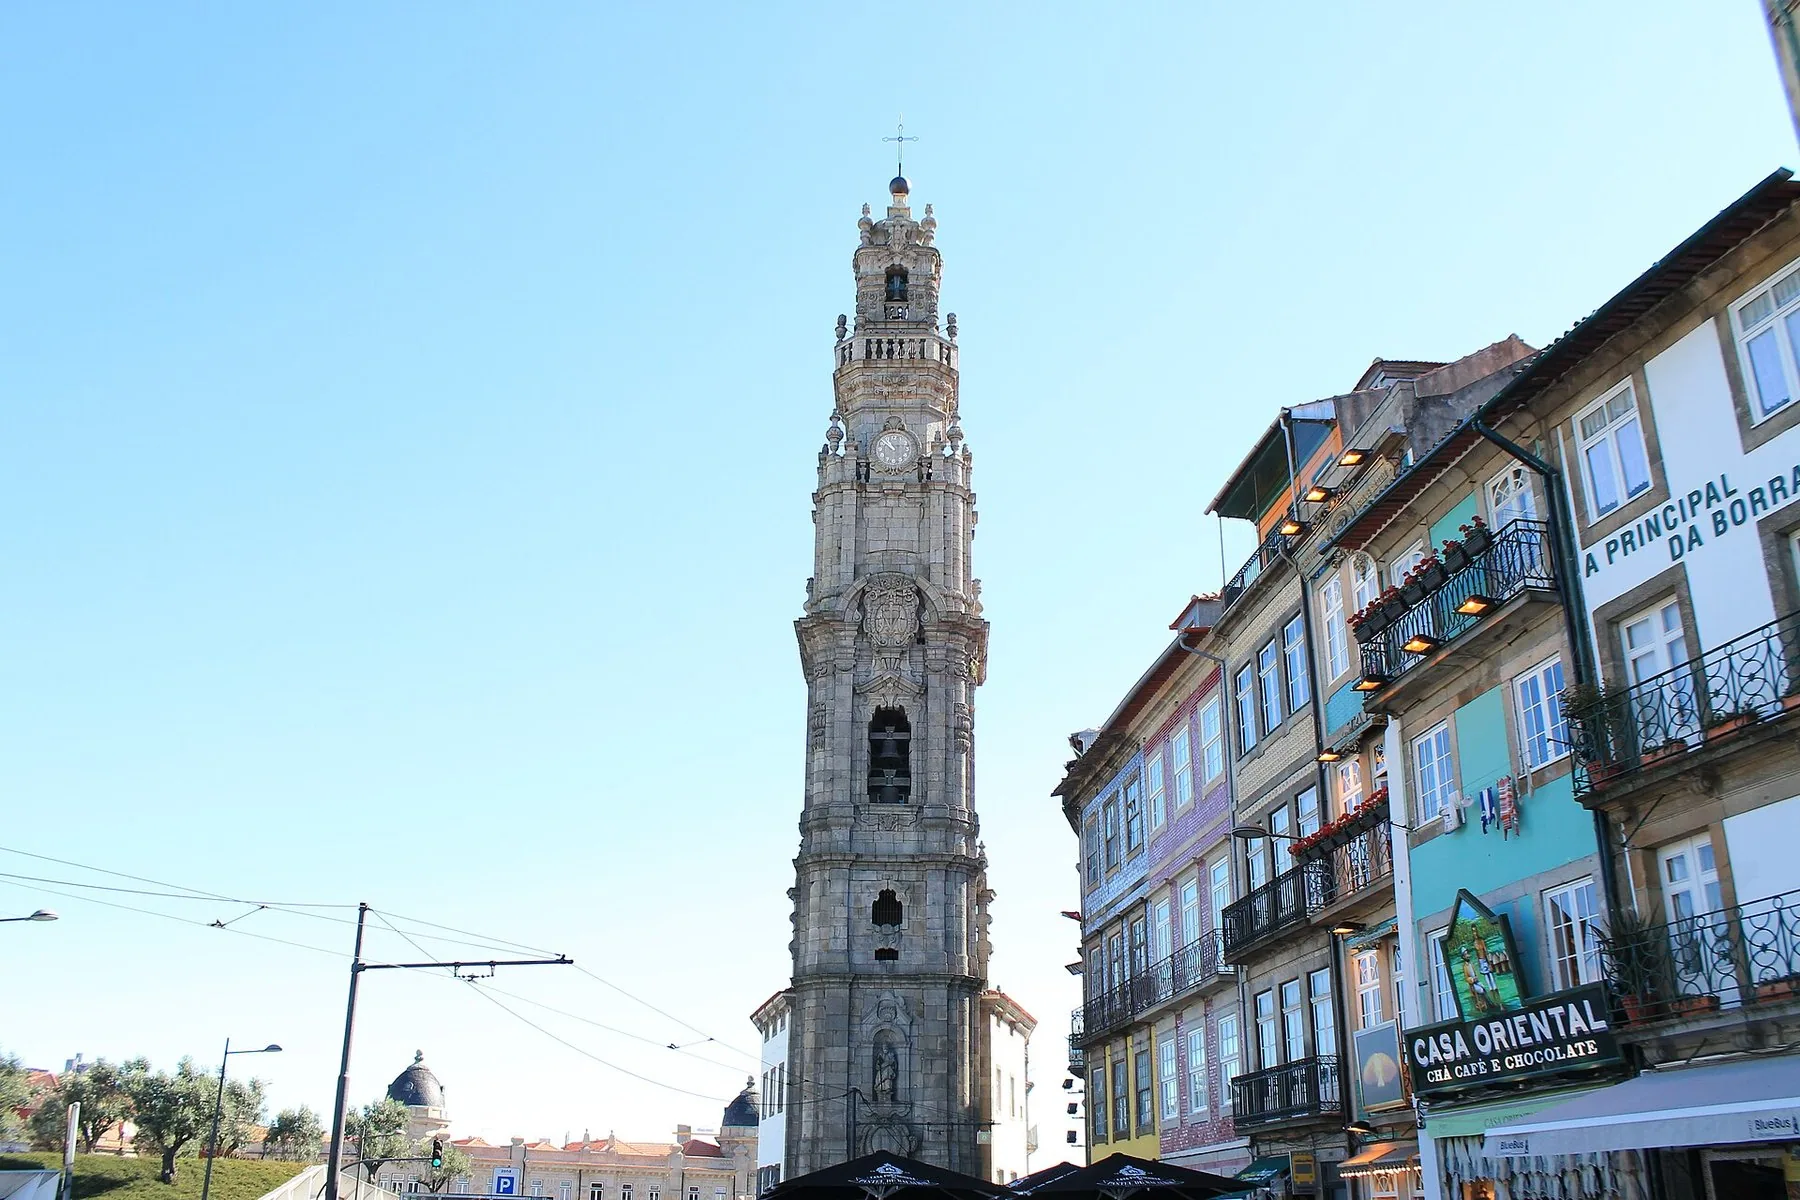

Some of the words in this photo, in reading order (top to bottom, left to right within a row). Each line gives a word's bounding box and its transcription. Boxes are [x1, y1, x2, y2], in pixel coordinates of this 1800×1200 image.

[1585, 552, 1600, 578] A
[1605, 473, 1738, 565] PRINCIPAL
[1668, 524, 1704, 562] DA
[1413, 1030, 1471, 1068] CASA
[1473, 999, 1608, 1056] ORIENTAL
[1490, 1058, 1501, 1072] E
[1504, 1039, 1598, 1070] CHOCOLATE
[1754, 1117, 1792, 1130] BlueBus
[1500, 1139, 1525, 1150] BlueBus
[499, 1178, 511, 1193] P
